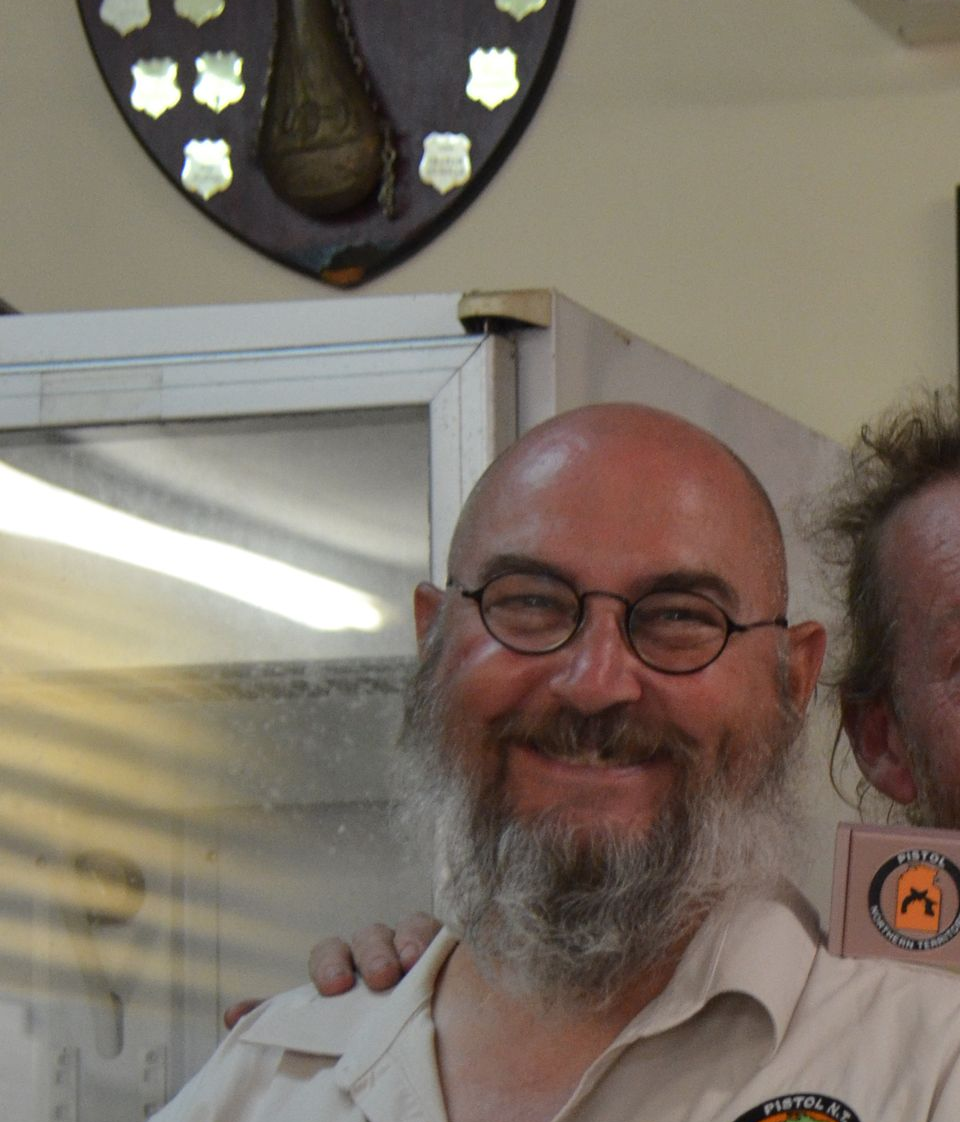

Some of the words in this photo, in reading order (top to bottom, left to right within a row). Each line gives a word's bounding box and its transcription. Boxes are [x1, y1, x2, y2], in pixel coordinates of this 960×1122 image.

[897, 850, 945, 868] PISTOL
[870, 904, 914, 950] NORTHERN
[763, 1095, 825, 1116] PISTOL
